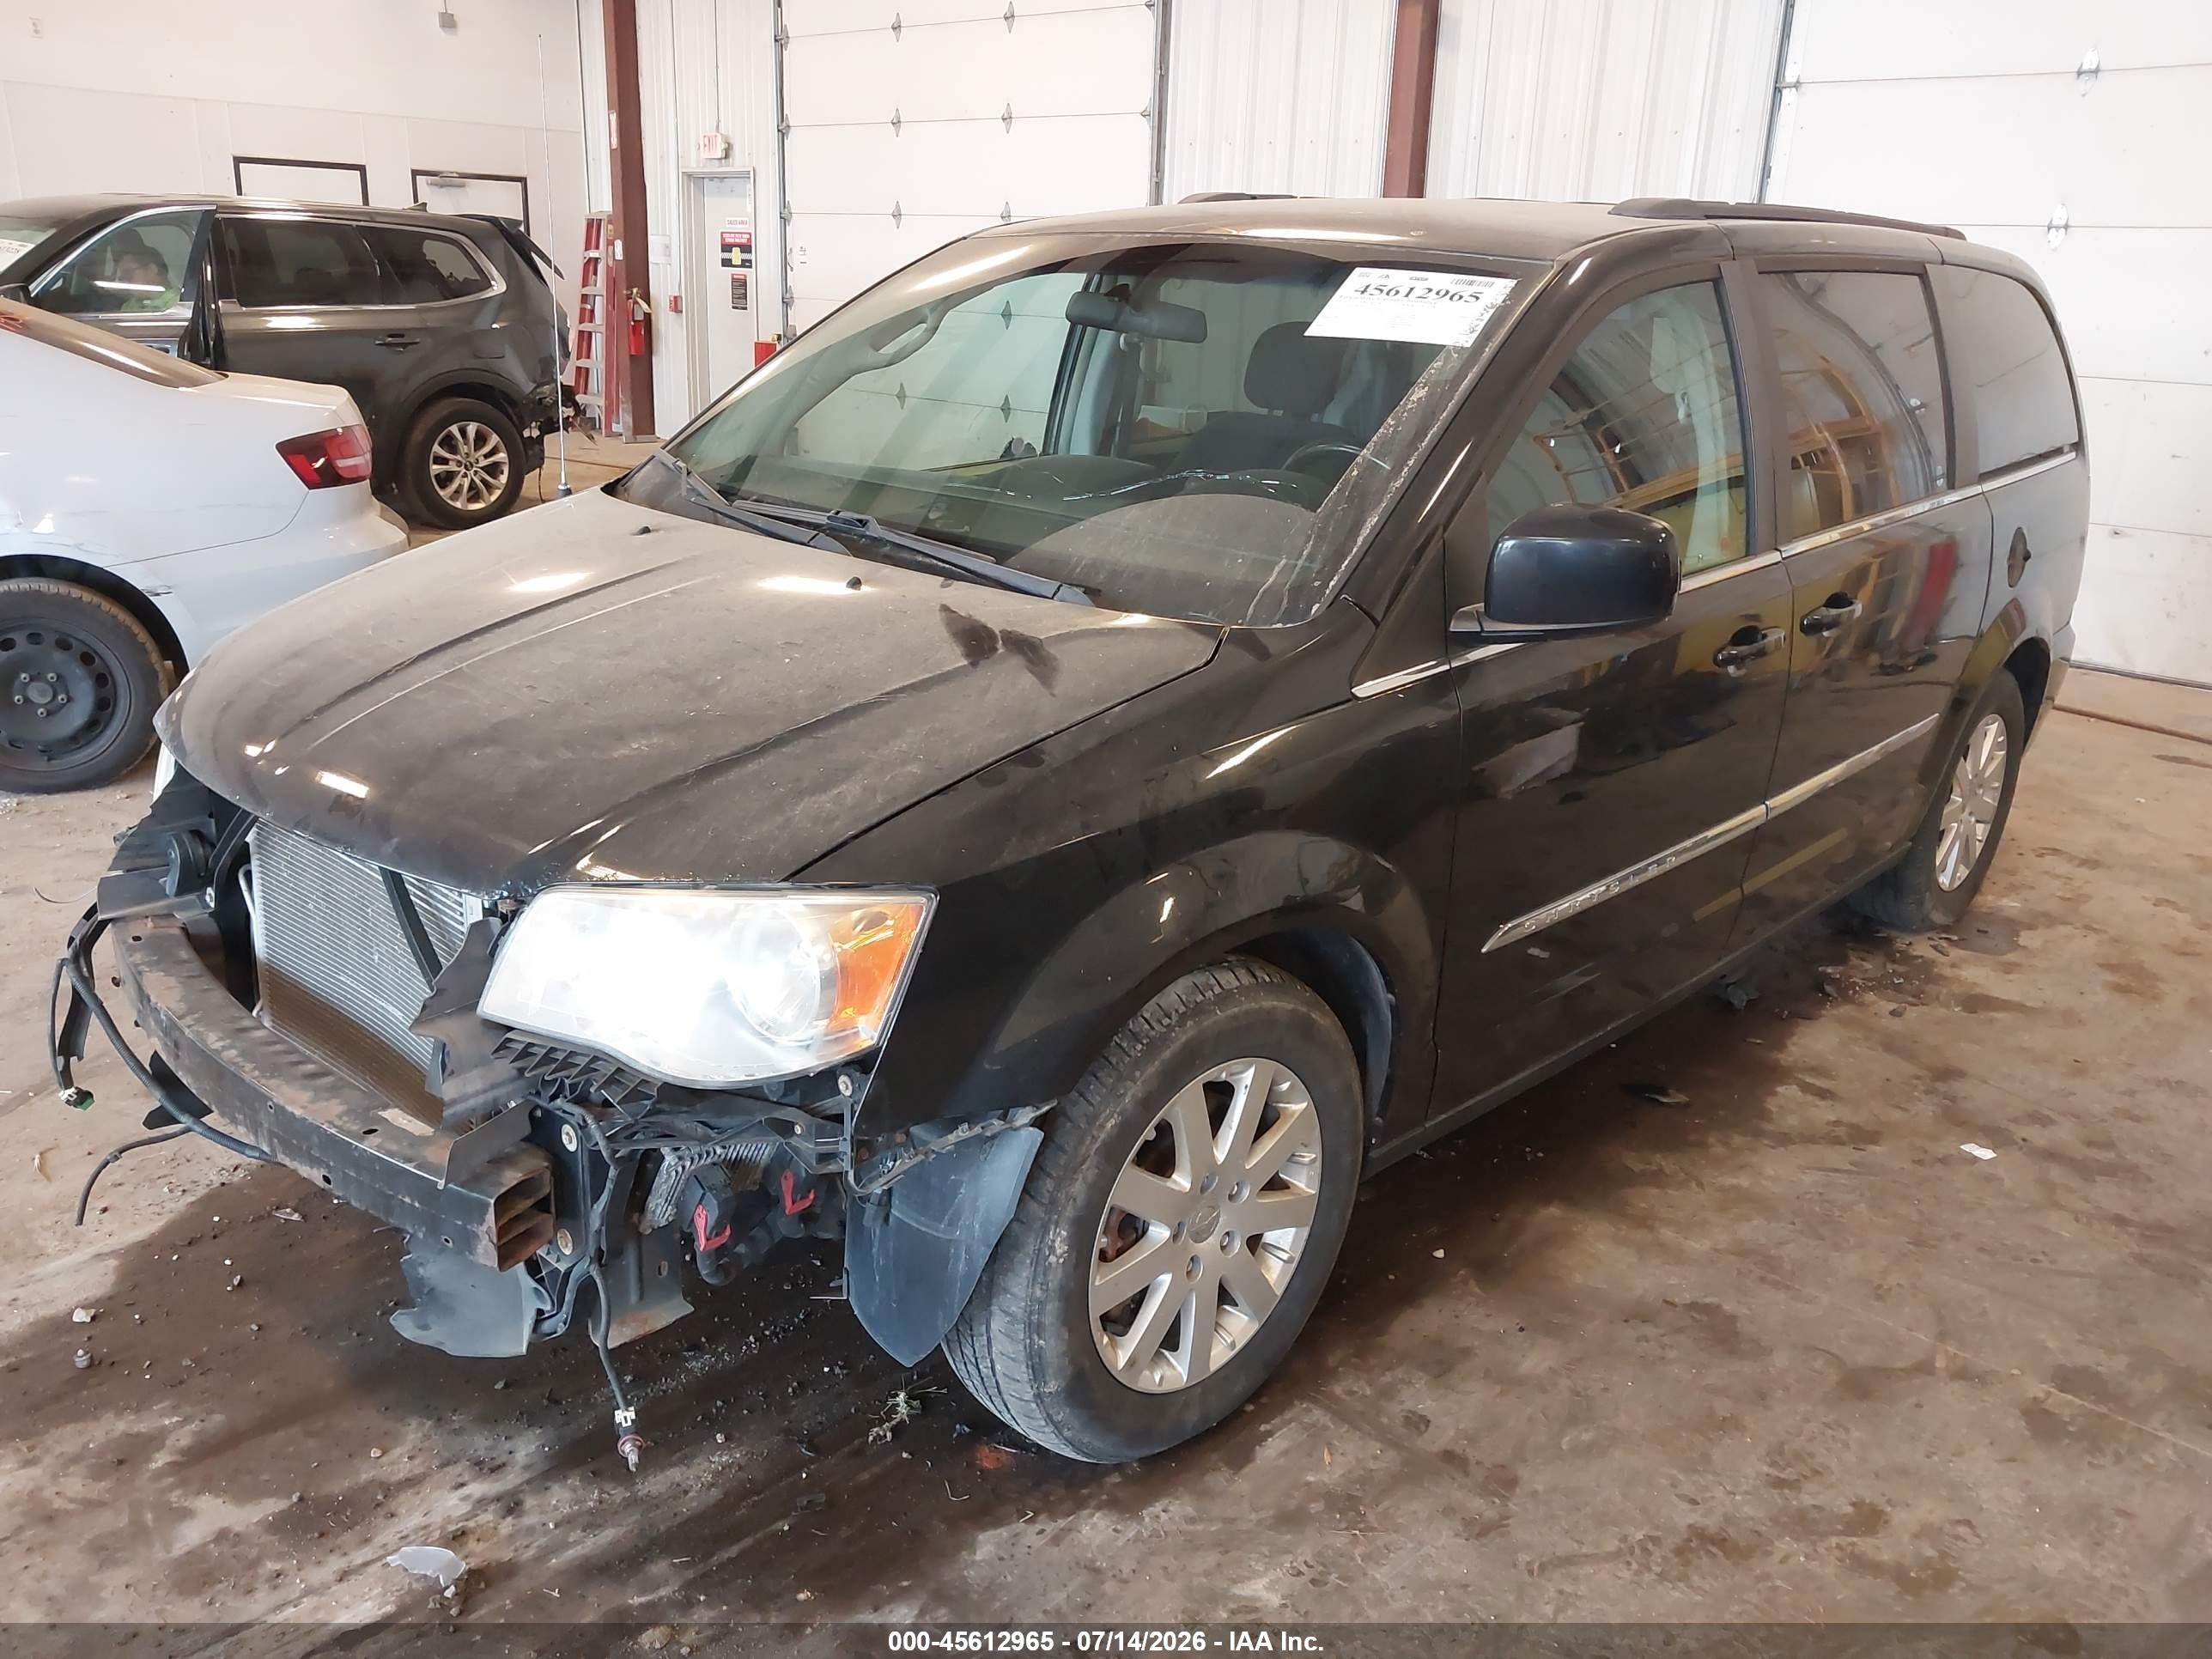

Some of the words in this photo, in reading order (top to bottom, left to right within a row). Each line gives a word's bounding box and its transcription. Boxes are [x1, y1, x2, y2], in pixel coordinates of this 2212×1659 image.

[702, 134, 718, 152] EXIT
[1354, 283, 1485, 304] 45612965
[1523, 855, 1676, 933] CHRYSLER
